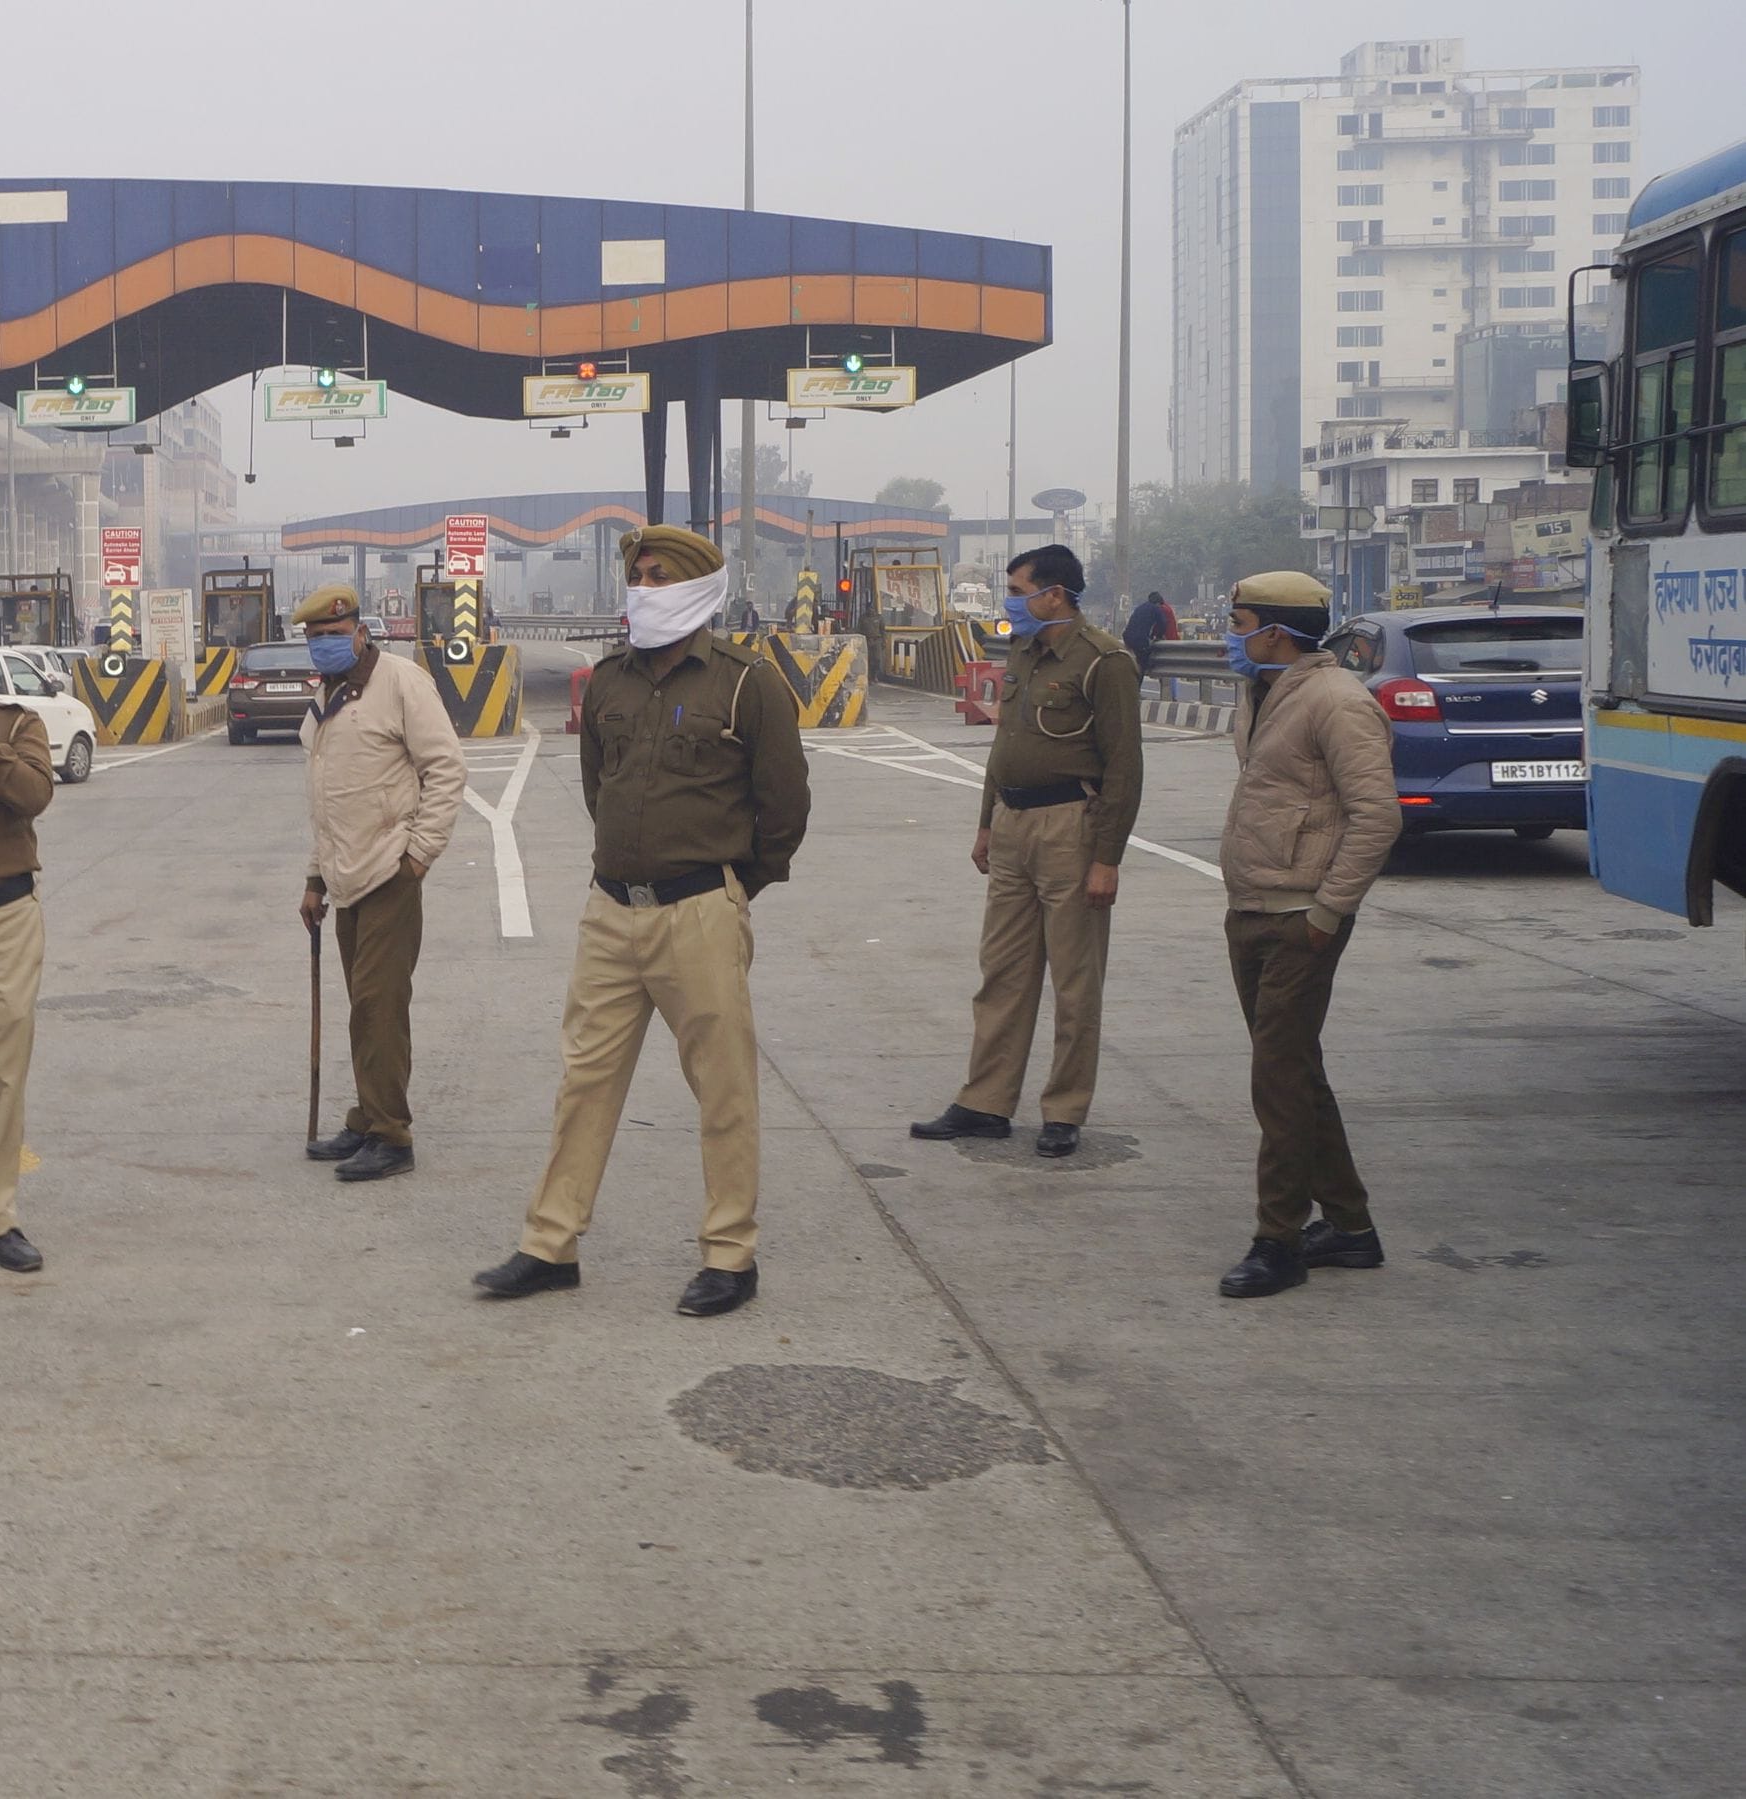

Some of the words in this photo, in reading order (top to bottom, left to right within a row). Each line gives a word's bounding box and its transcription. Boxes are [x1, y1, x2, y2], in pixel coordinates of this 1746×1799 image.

[448, 518, 485, 527] CAUTION
[104, 530, 140, 538] CAUTION
[1445, 694, 1483, 703] BALENO
